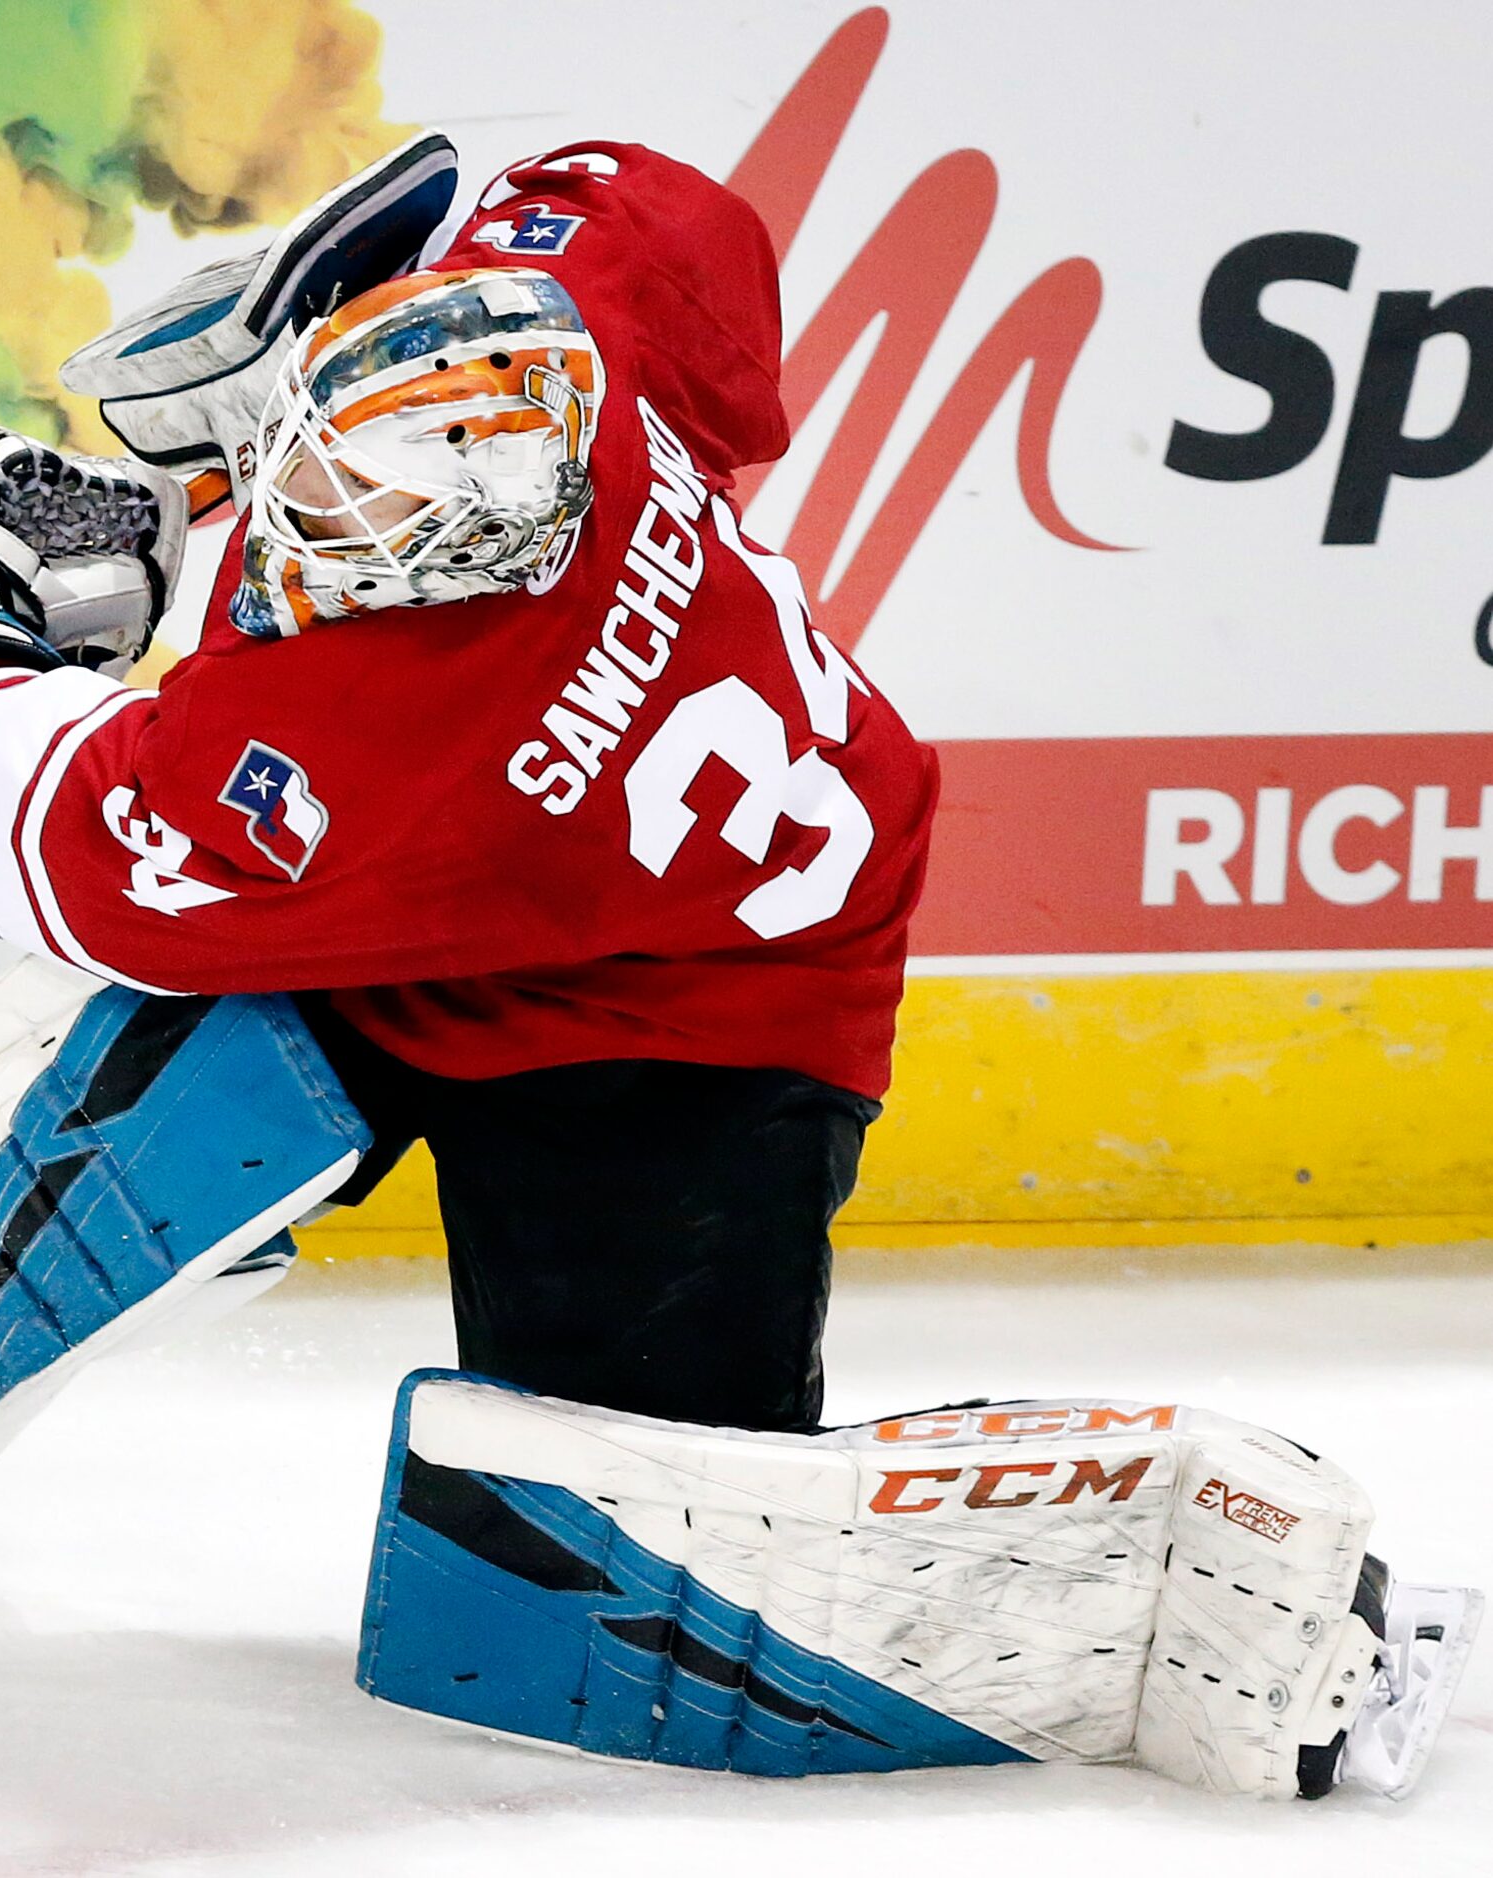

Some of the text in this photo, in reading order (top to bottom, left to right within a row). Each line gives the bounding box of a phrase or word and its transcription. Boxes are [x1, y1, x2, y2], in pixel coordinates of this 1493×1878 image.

[1141, 783, 1493, 907] RICH
[872, 1404, 1178, 1444] CCM
[868, 1456, 1155, 1515] CCM
[1191, 1477, 1302, 1532] EXTREME
